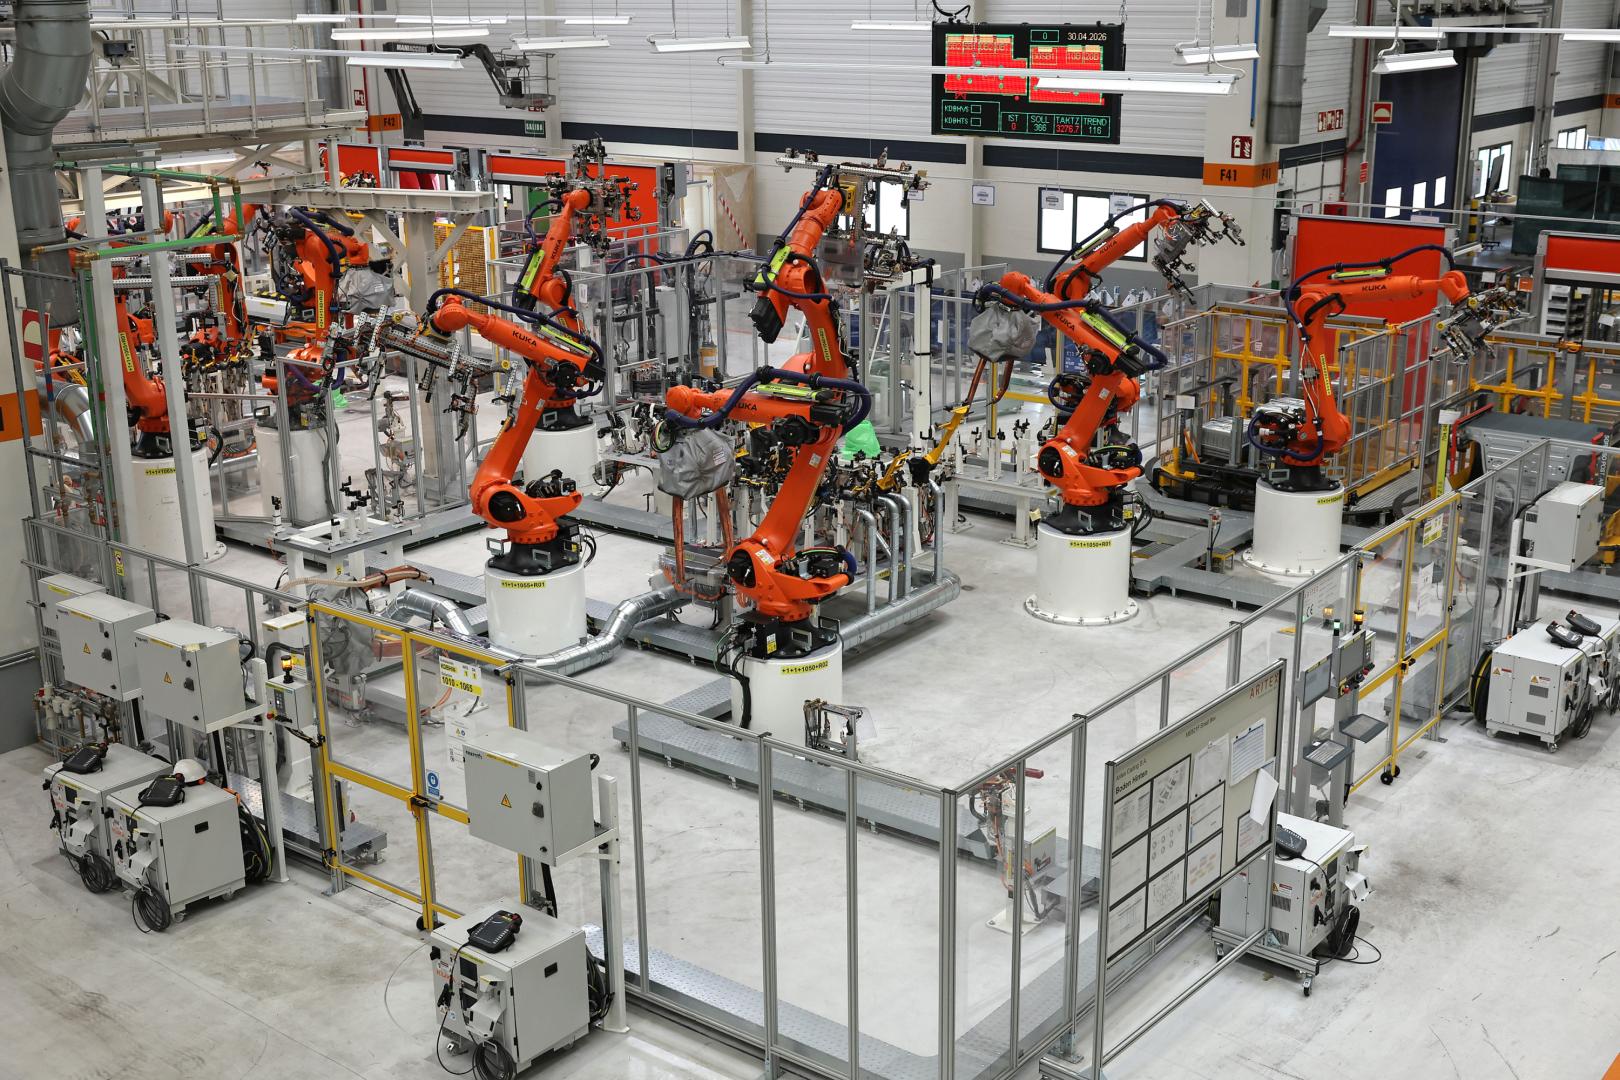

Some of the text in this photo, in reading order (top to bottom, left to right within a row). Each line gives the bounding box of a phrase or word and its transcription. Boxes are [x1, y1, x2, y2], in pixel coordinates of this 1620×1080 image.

[1043, 32, 1047, 40] 0
[1067, 32, 1107, 41] 30.04.2026
[1008, 114, 1019, 122] IST
[1030, 115, 1050, 124] SOLL
[1084, 117, 1107, 126] TREND
[1056, 125, 1079, 133] 3276.7
[1220, 168, 1238, 182] F41
[1261, 167, 1272, 181] F41
[551, 239, 562, 260] KUKA
[1055, 312, 1075, 333] KUKA
[512, 330, 537, 348] KUKA
[738, 402, 757, 411] UKA
[441, 676, 455, 687] 1010
[1249, 672, 1280, 700] ARITEX
